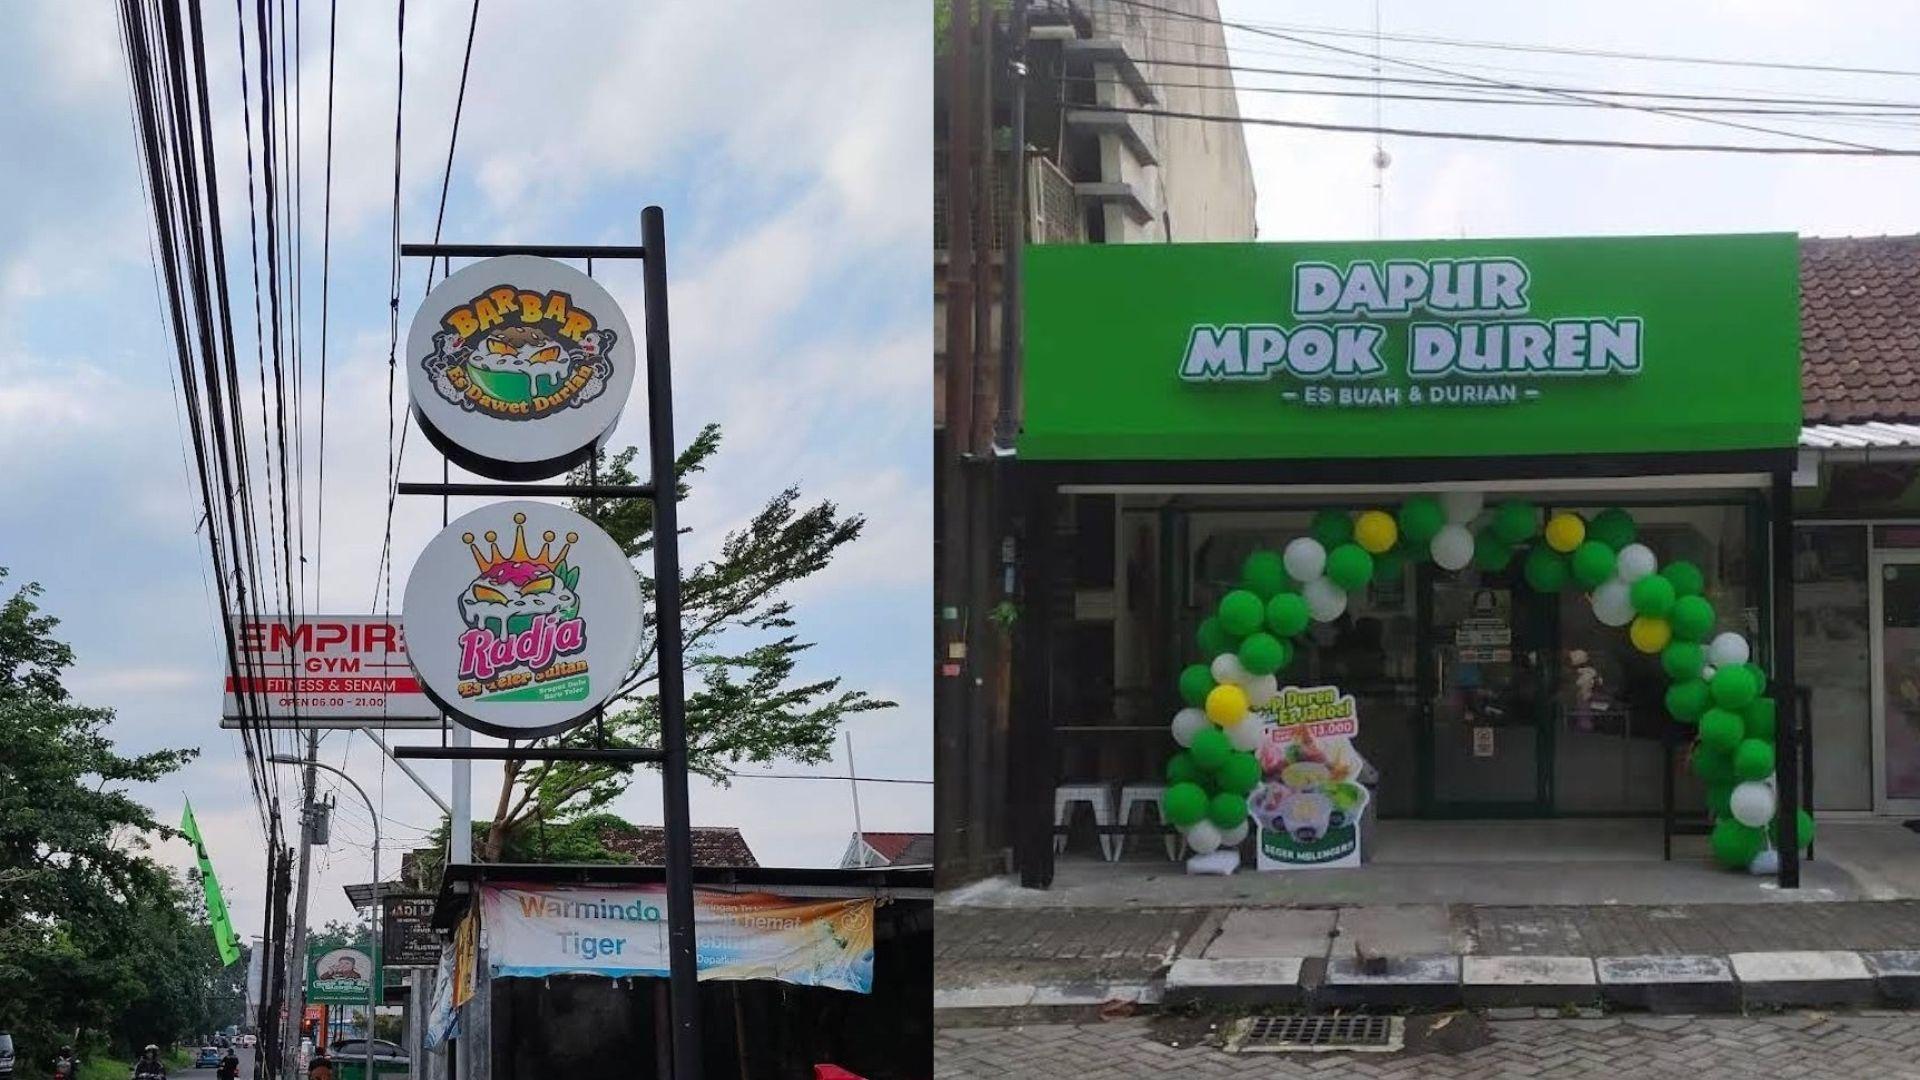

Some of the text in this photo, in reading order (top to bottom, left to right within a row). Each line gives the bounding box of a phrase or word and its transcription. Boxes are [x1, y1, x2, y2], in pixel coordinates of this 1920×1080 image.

[1295, 259, 1528, 316] DAPUR
[446, 287, 594, 342] BARBAR
[1182, 319, 1641, 377] MPOK DUREN
[447, 365, 594, 413] Es Dawet Durian
[1304, 385, 1517, 404] ES BUAH & DURIAN
[305, 657, 361, 673] GYM
[460, 613, 584, 680] Radja
[267, 680, 396, 692] FITNESS & SENAM
[518, 895, 661, 921] Warmindo
[557, 931, 627, 960] Tiger
